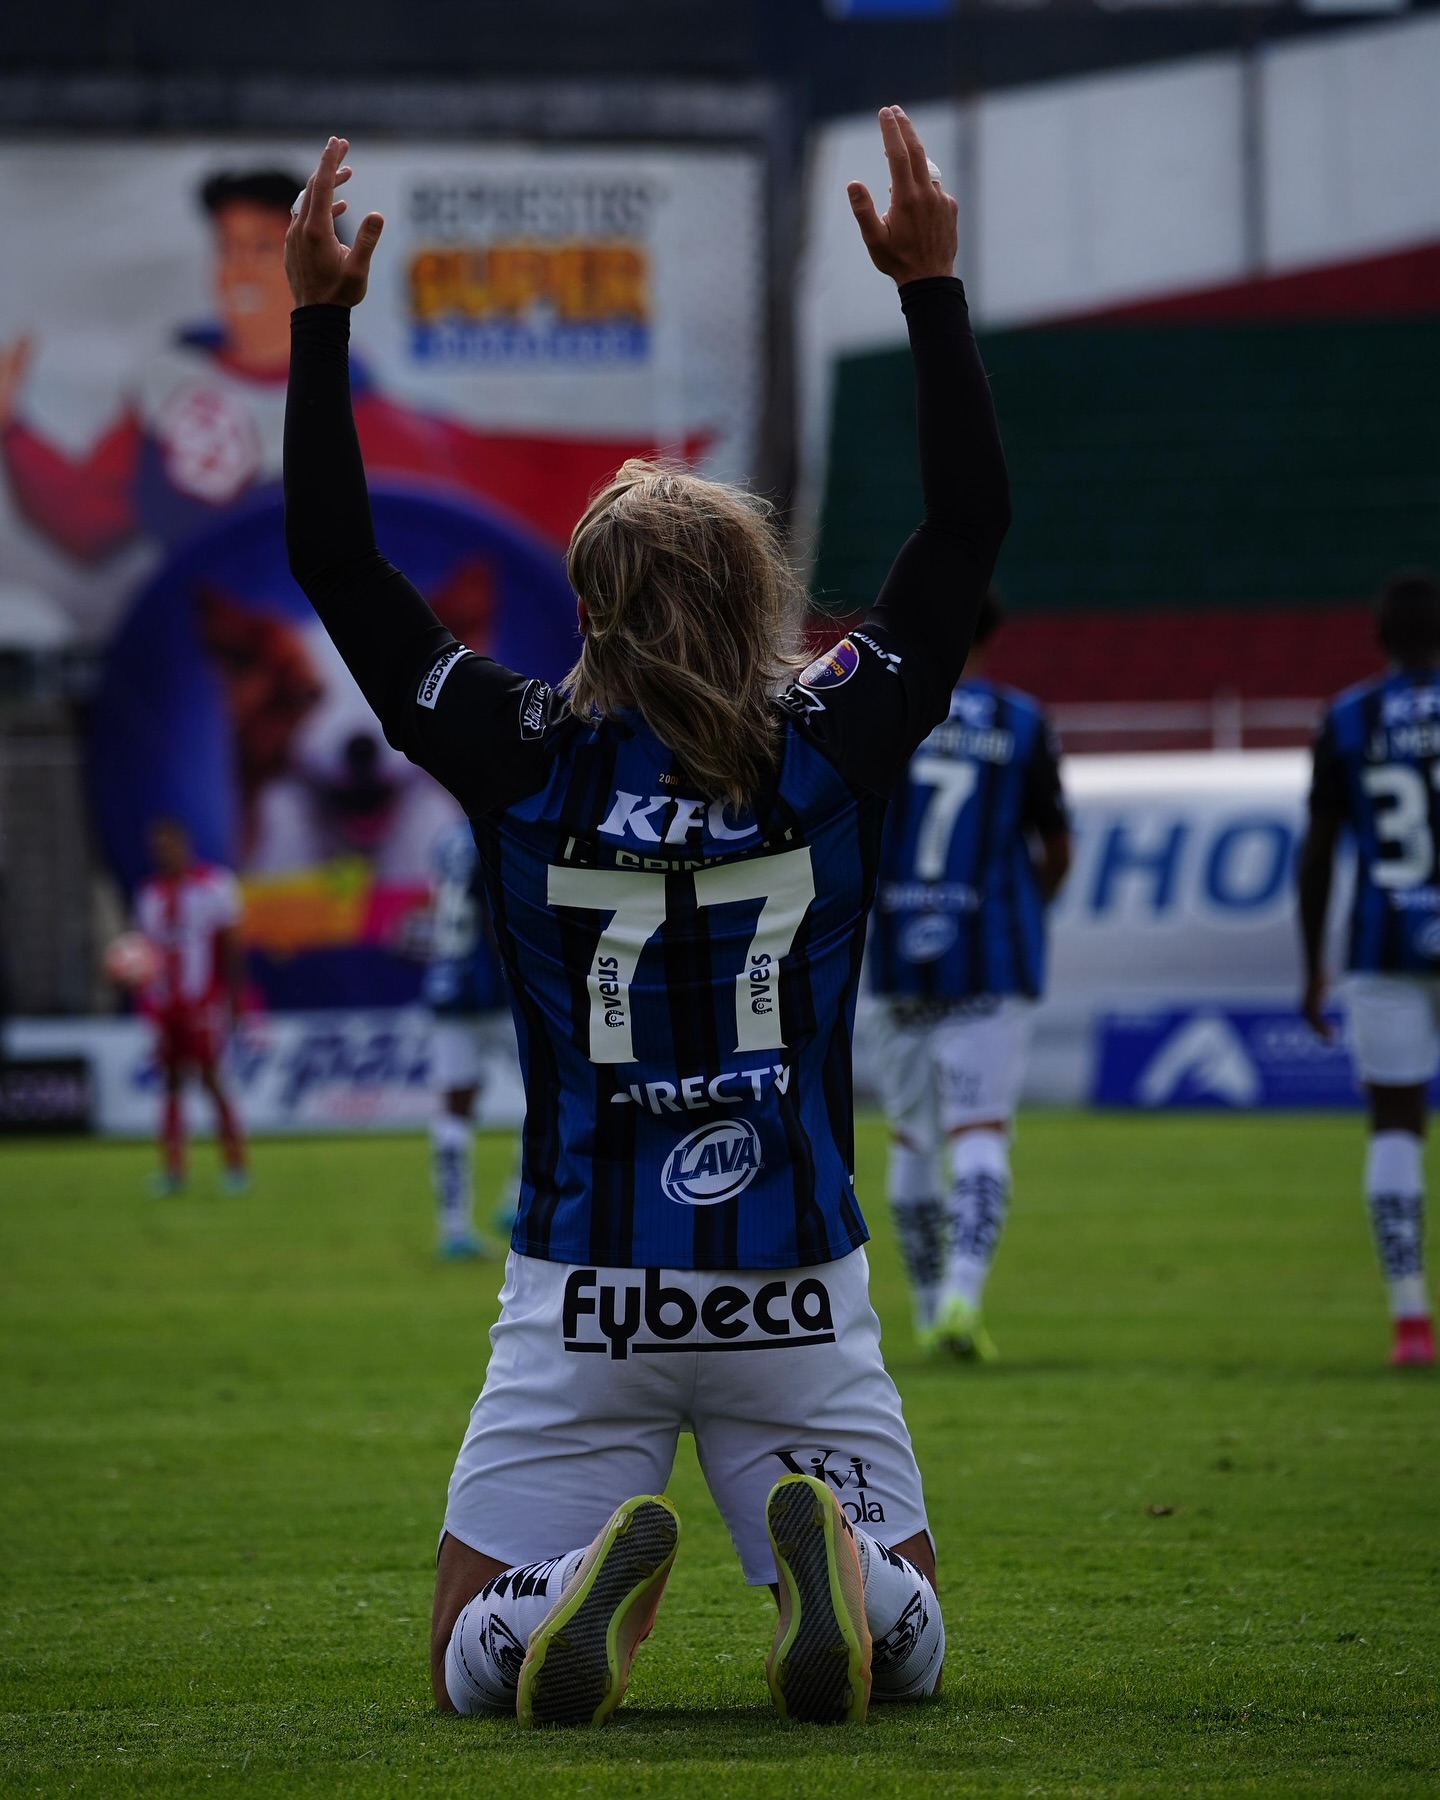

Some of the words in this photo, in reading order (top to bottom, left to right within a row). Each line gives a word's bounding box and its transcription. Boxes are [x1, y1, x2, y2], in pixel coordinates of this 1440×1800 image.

[596, 789, 759, 846] KFC
[909, 756, 979, 883] 7
[1360, 762, 1440, 890] 3
[547, 845, 816, 1063] 77
[666, 1135, 758, 1185] LAVA
[840, 1491, 886, 1523] ola
